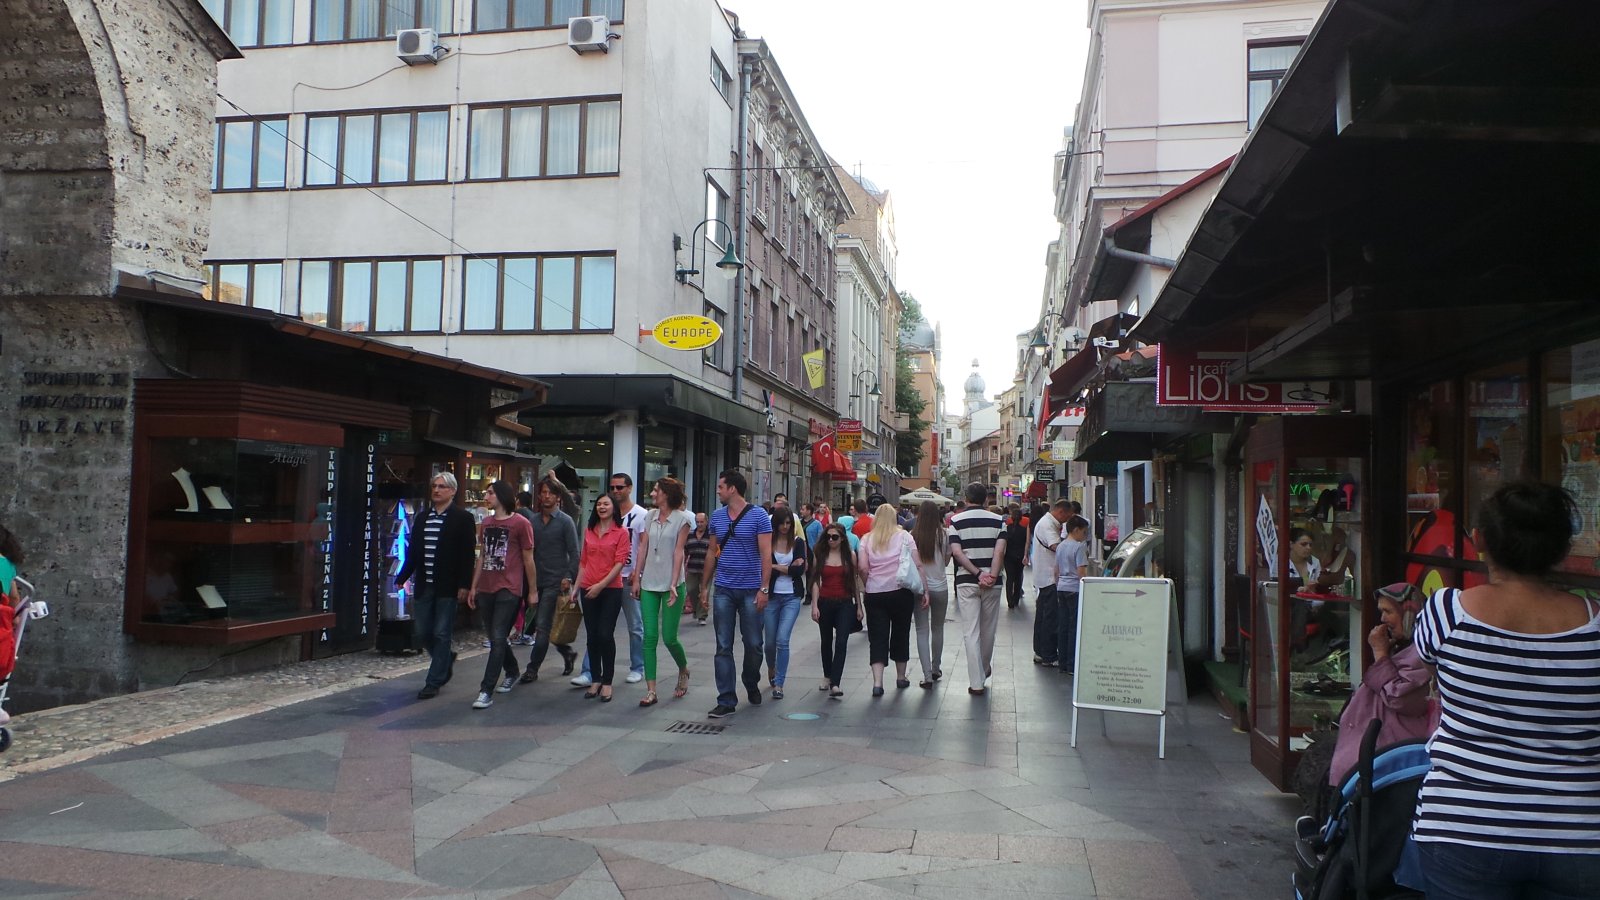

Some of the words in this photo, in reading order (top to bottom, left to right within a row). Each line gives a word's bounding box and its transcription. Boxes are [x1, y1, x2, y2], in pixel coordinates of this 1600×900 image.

[654, 317, 673, 332] TOURIST
[664, 327, 712, 338] EUROPE
[327, 447, 335, 492] TKUP
[366, 444, 375, 493] OTKUP
[328, 496, 332, 506] I
[367, 497, 371, 507] I
[363, 511, 372, 580] ZAMJENA
[320, 589, 329, 642] ZLA
[361, 585, 369, 635] ZLATA
[1096, 694, 1116, 702] 09:00
[1122, 696, 1142, 704] 22:00
